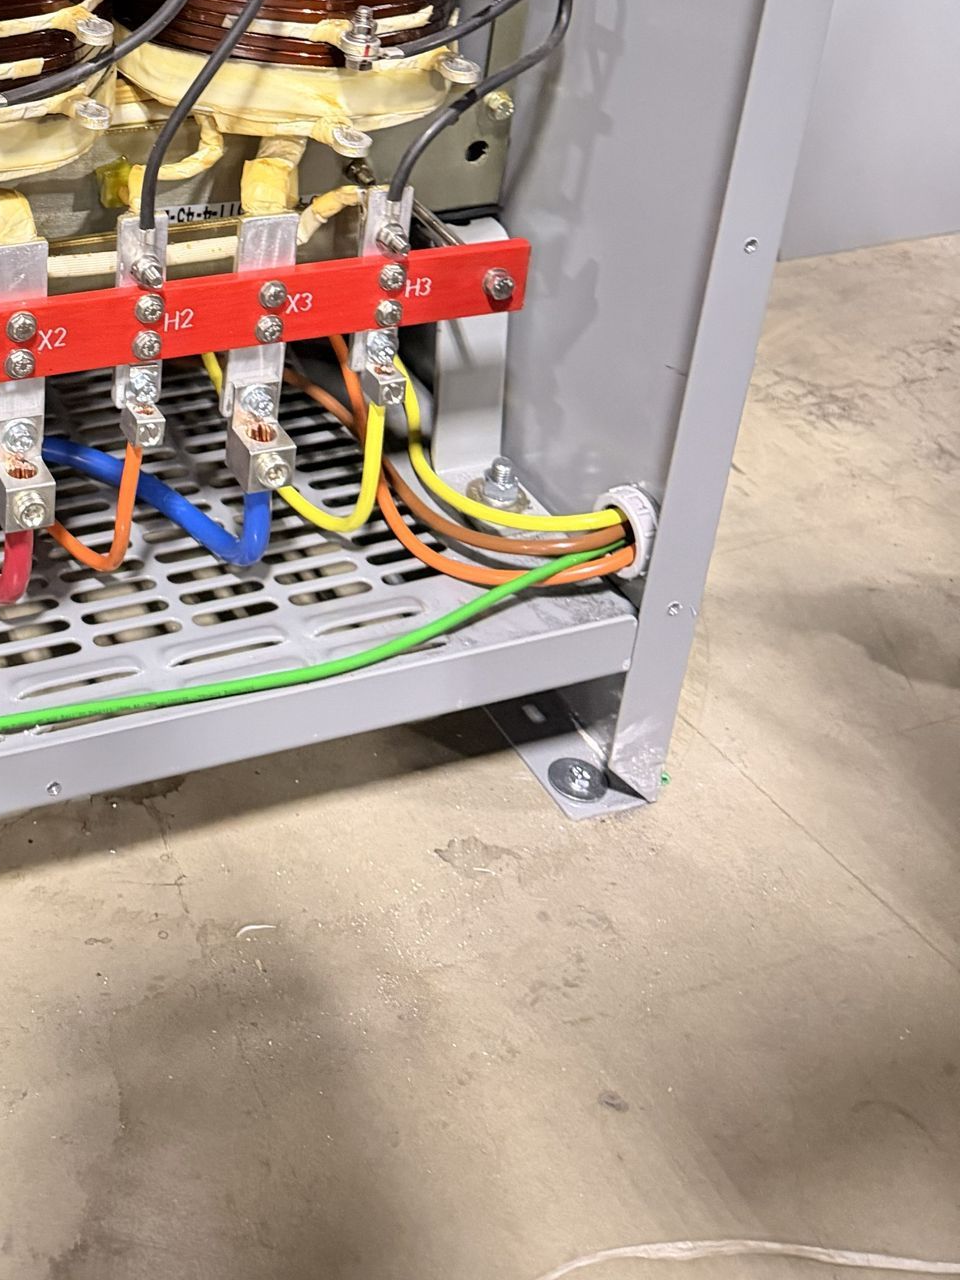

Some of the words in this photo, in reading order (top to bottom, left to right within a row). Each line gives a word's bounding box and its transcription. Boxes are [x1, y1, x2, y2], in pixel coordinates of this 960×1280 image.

[404, 277, 432, 298] H3
[286, 292, 314, 315] X3
[163, 307, 194, 333] H2
[37, 326, 67, 352] X2
